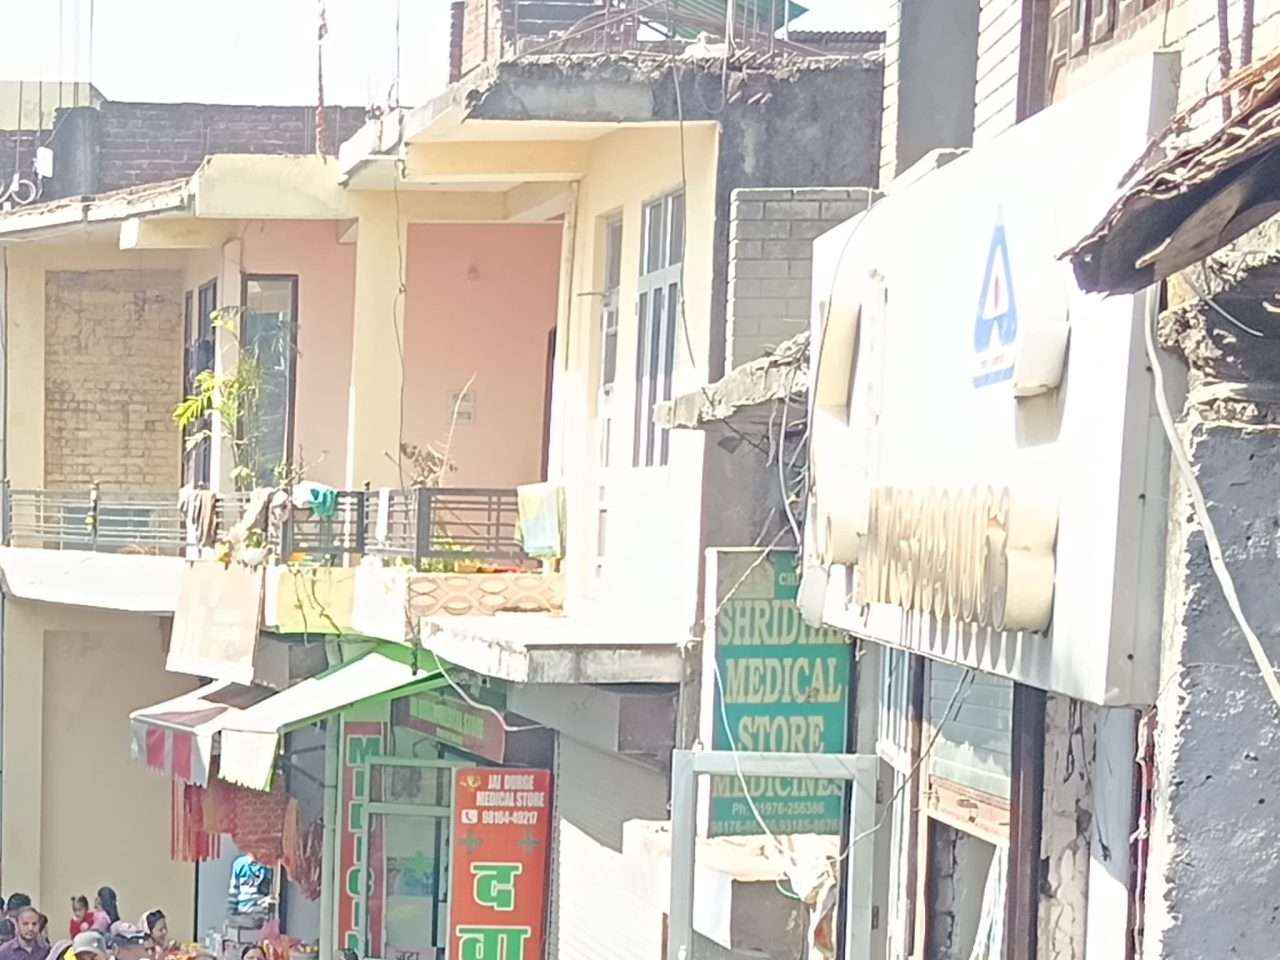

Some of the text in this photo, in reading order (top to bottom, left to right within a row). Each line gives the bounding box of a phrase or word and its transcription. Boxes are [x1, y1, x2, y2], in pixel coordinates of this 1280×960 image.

[720, 600, 845, 645] SHRID
[725, 657, 842, 703] MEDICAL
[738, 715, 824, 753] STORE
[476, 791, 545, 807] MEDICAL STORE
